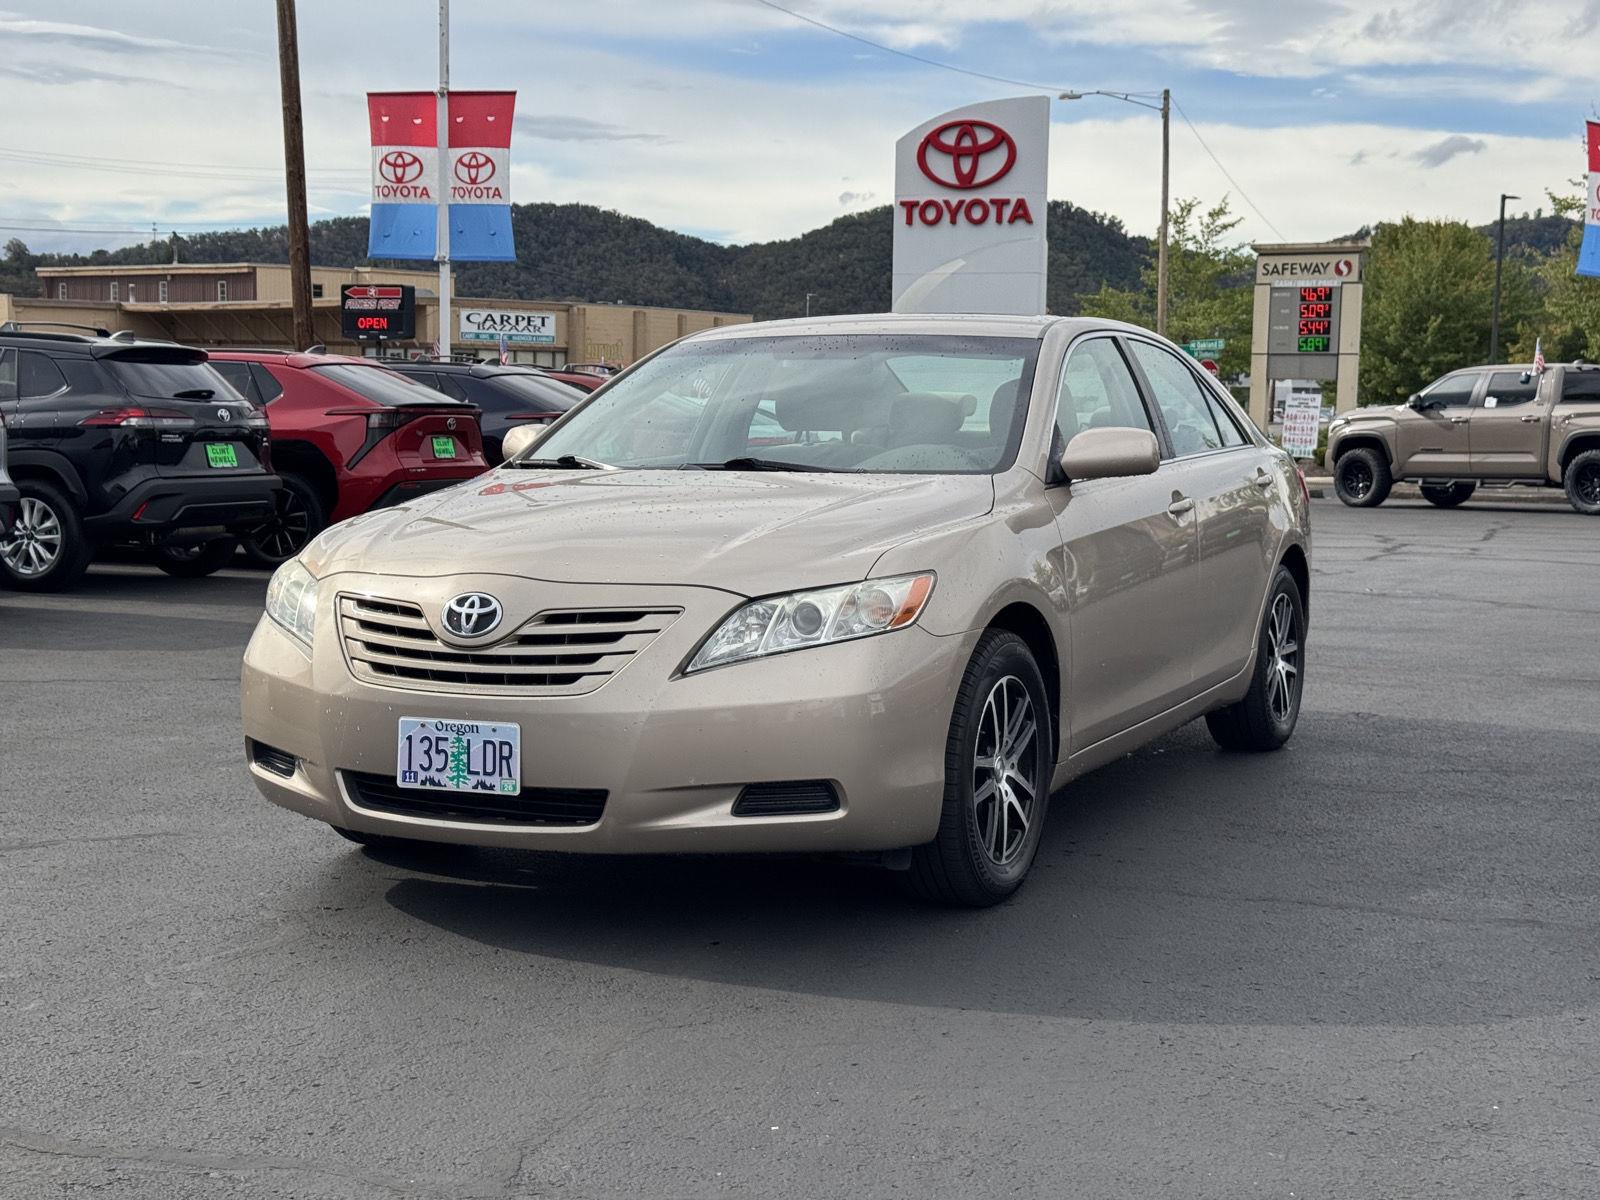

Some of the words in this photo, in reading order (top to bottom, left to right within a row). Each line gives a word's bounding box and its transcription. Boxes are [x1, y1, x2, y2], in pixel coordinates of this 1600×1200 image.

[375, 185, 431, 199] TOYOTA
[451, 186, 502, 200] TOYOTA
[900, 198, 1033, 226] TOYOTA
[1262, 262, 1330, 276] SAFEWAY
[358, 317, 388, 329] OPEN
[466, 312, 550, 328] CARPET
[477, 321, 542, 334] BAZAAR
[211, 447, 230, 455] CLINT
[210, 455, 236, 463] NEWELL
[435, 720, 480, 736] Oregon
[406, 734, 449, 773] 135
[466, 738, 513, 778] LDR
[405, 772, 415, 782] 11
